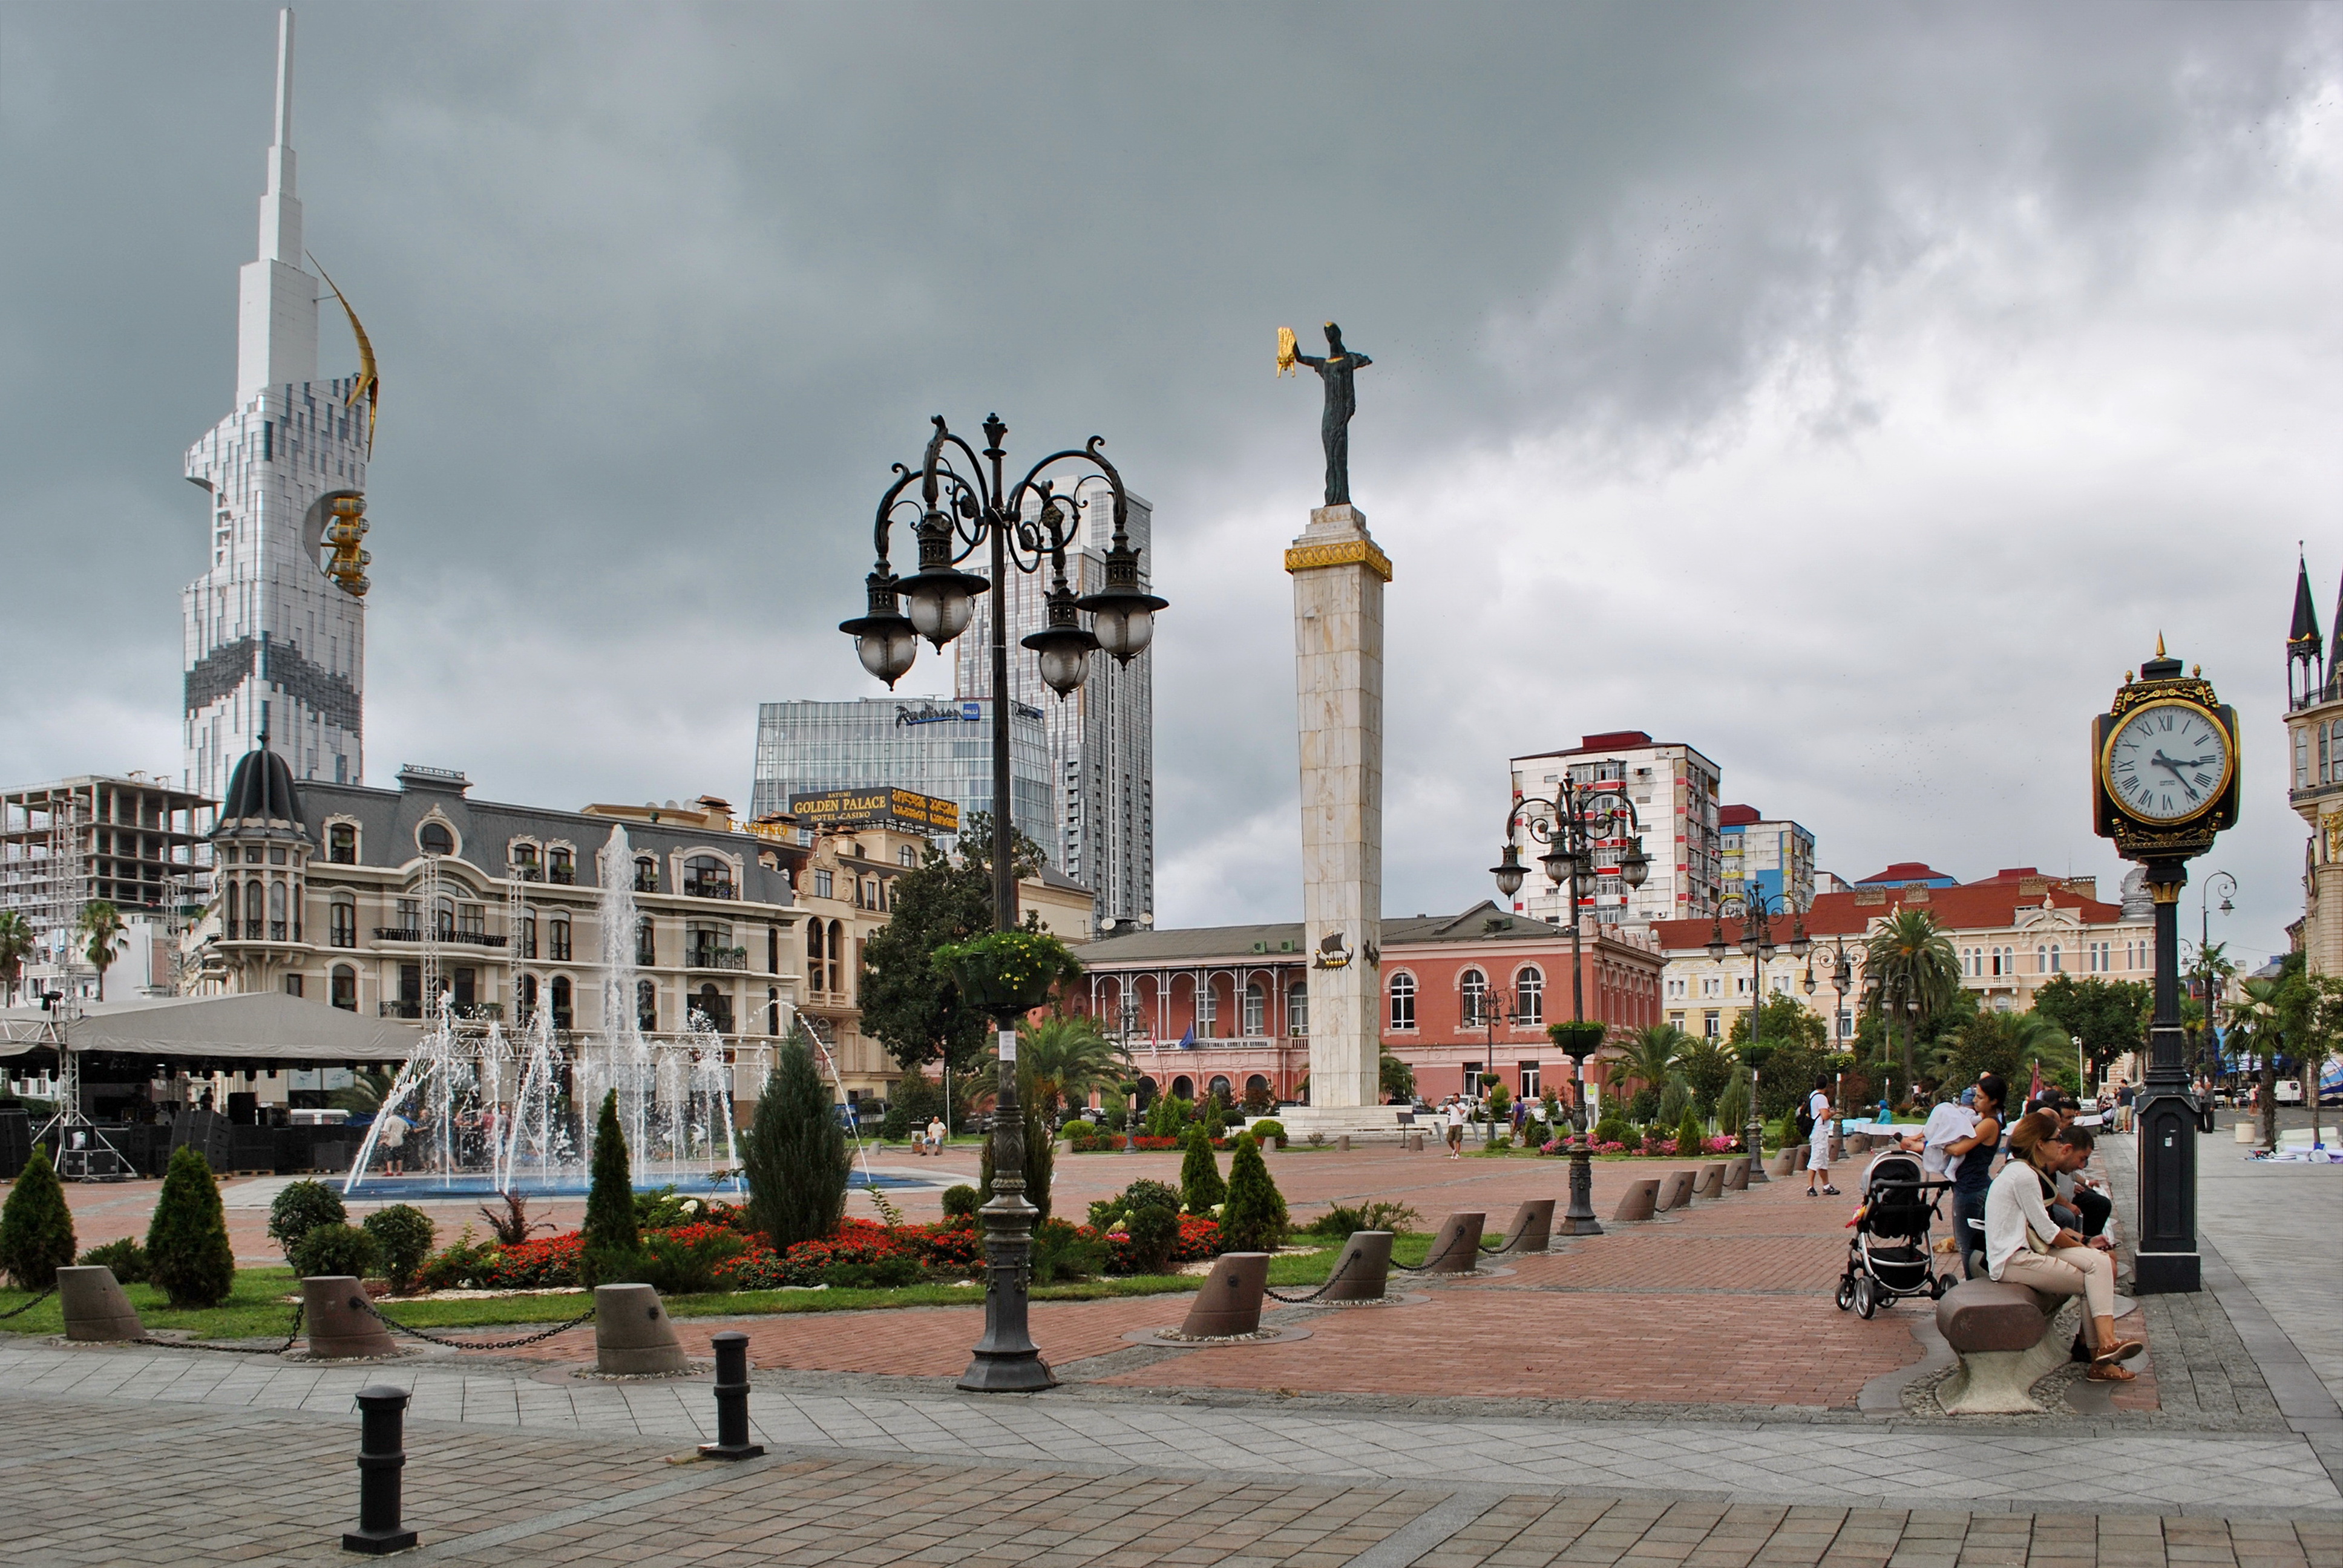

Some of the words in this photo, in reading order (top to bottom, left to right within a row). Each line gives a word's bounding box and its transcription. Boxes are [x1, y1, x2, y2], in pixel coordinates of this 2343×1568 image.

[794, 799, 839, 814] GOLDEN
[842, 795, 886, 811] PALACE
[811, 813, 837, 822] HOTEL
[840, 811, 871, 820] CASINO
[727, 820, 788, 837] CASINO
